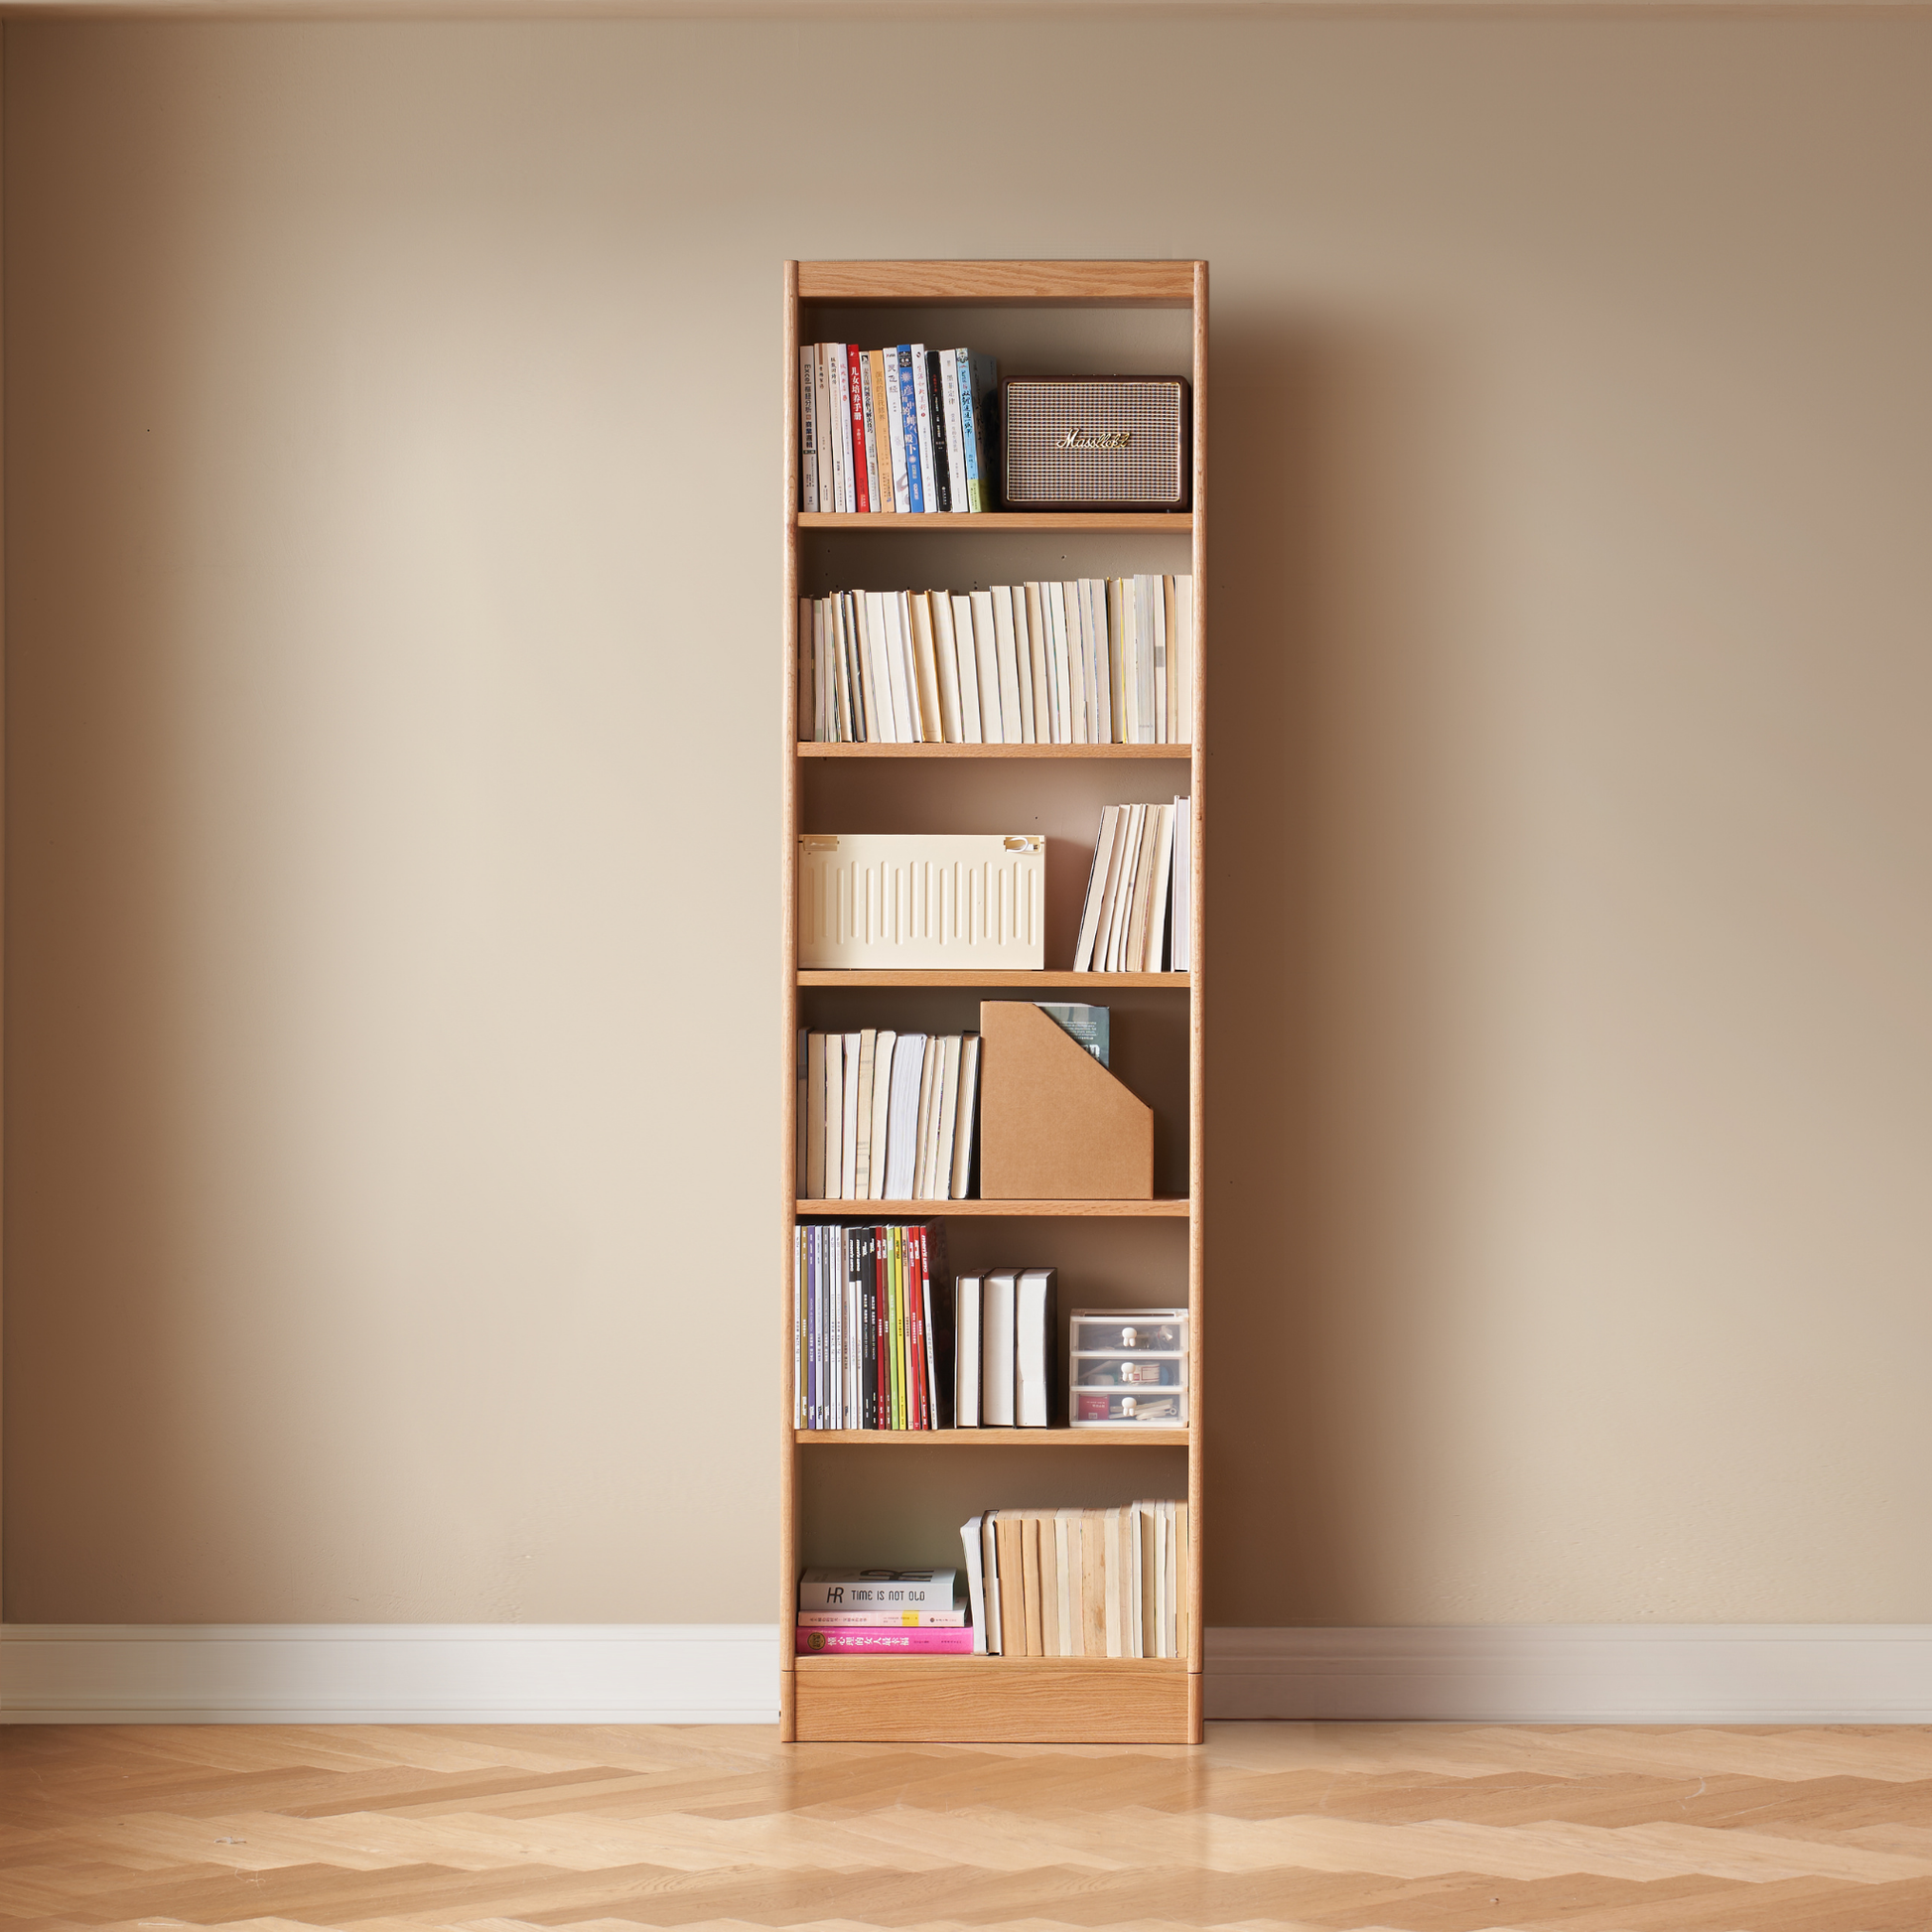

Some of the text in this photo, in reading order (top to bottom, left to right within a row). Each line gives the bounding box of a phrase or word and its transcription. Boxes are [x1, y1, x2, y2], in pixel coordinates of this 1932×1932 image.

[851, 367, 862, 420] 儿女培养手册
[826, 1587, 844, 1603] HR
[851, 1589, 873, 1601] TIME
[889, 1590, 904, 1601] NOT
[908, 1590, 925, 1601] OLD
